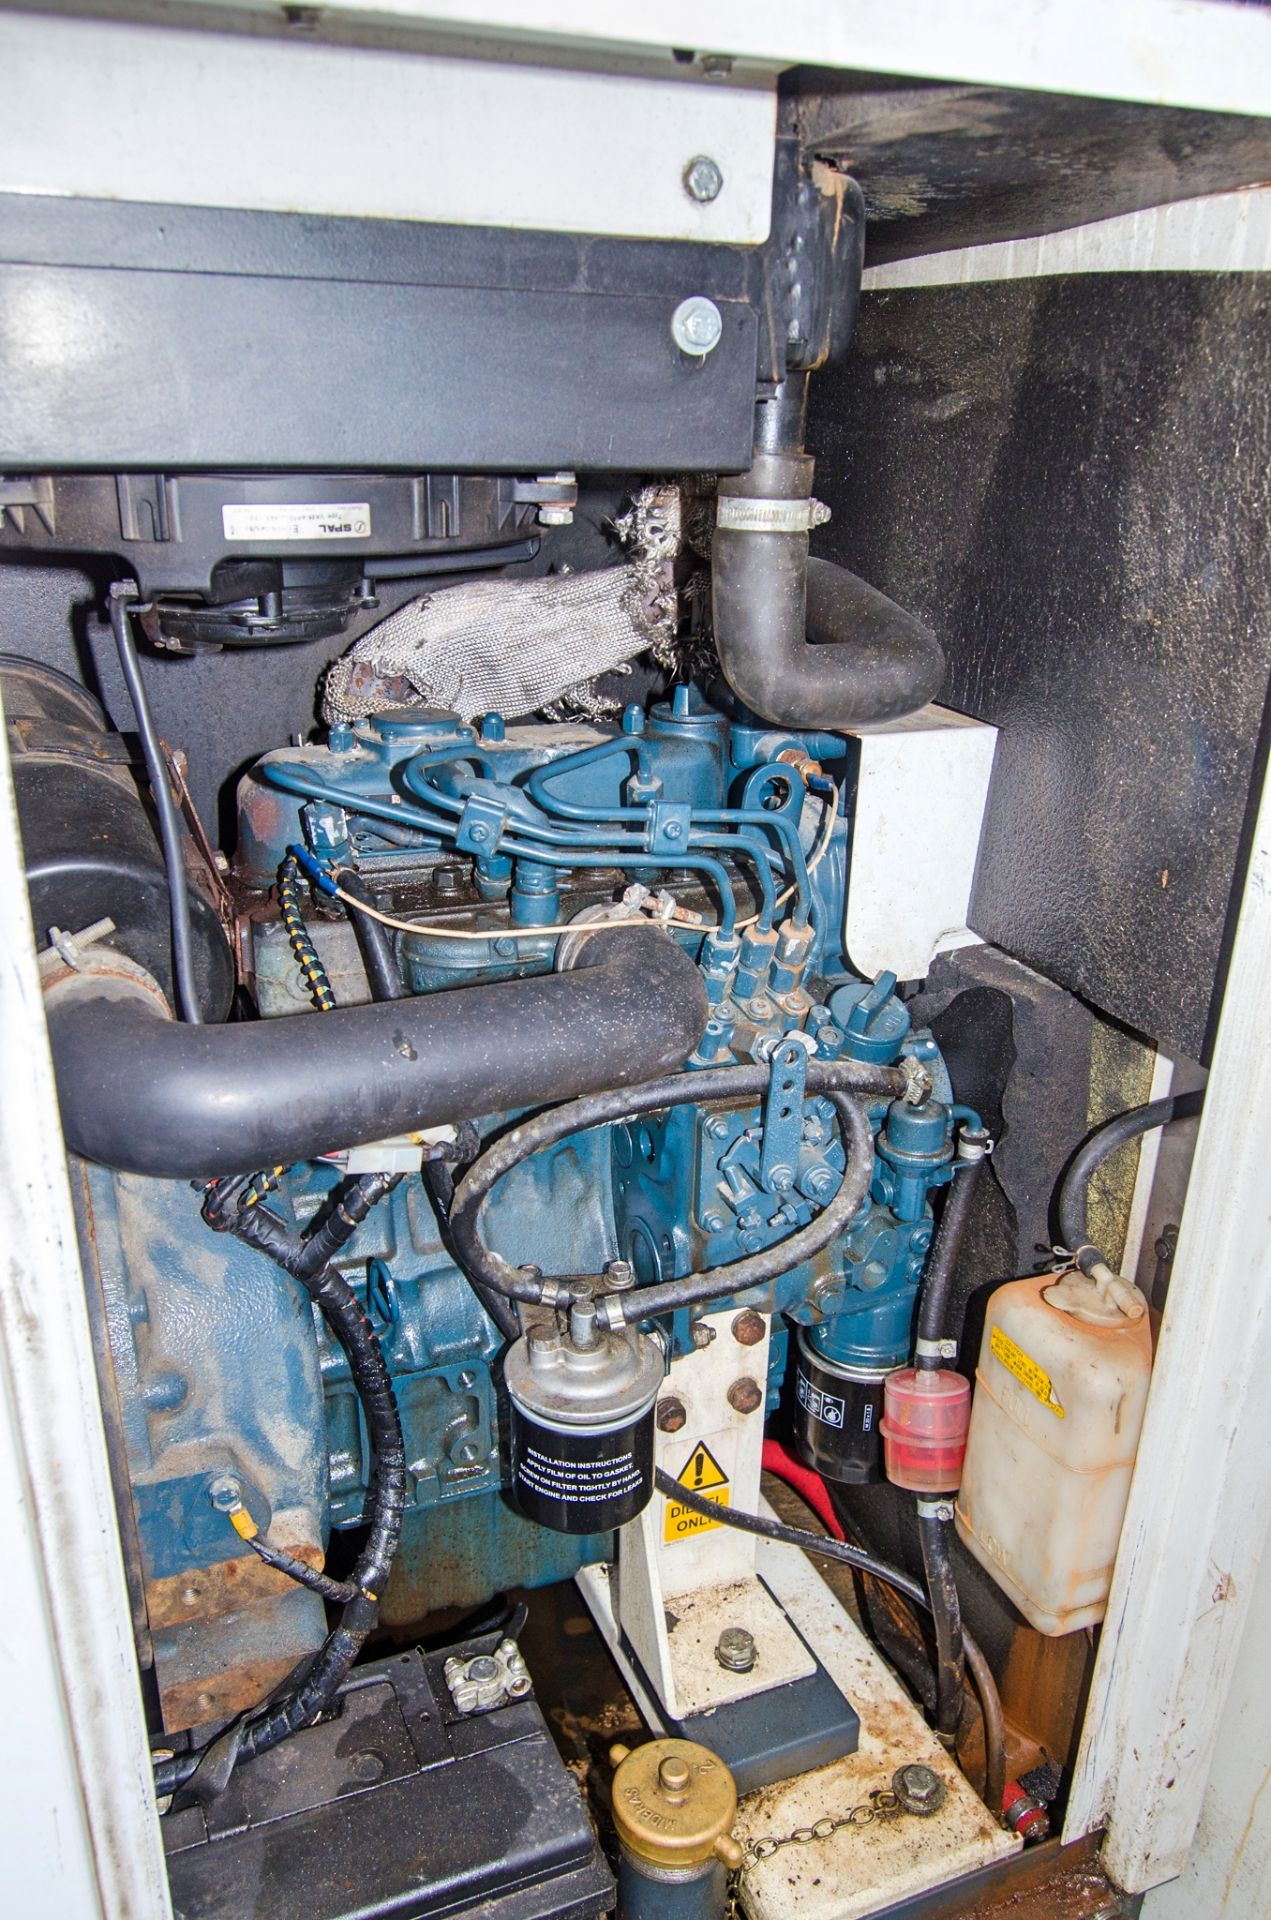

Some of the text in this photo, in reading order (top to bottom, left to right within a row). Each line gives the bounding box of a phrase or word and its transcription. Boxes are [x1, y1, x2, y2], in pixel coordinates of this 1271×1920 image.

[319, 524, 352, 533] SPAL
[527, 1458, 546, 1473] APPLY
[546, 1468, 564, 1479] FILM
[592, 1472, 603, 1480] TO
[604, 1462, 634, 1478] GASKET.
[528, 1447, 632, 1469] INSTALLATION INSTRUCTIONS
[519, 1471, 643, 1502] START ENGINE AND CHECK FOR LEAKS
[520, 1462, 539, 1481] SCREW
[540, 1478, 551, 1486] ON
[551, 1481, 580, 1491] FILTER
[579, 1481, 611, 1491] TIGHTLY
[611, 1478, 622, 1487] BY
[676, 1514, 713, 1532] ONL
